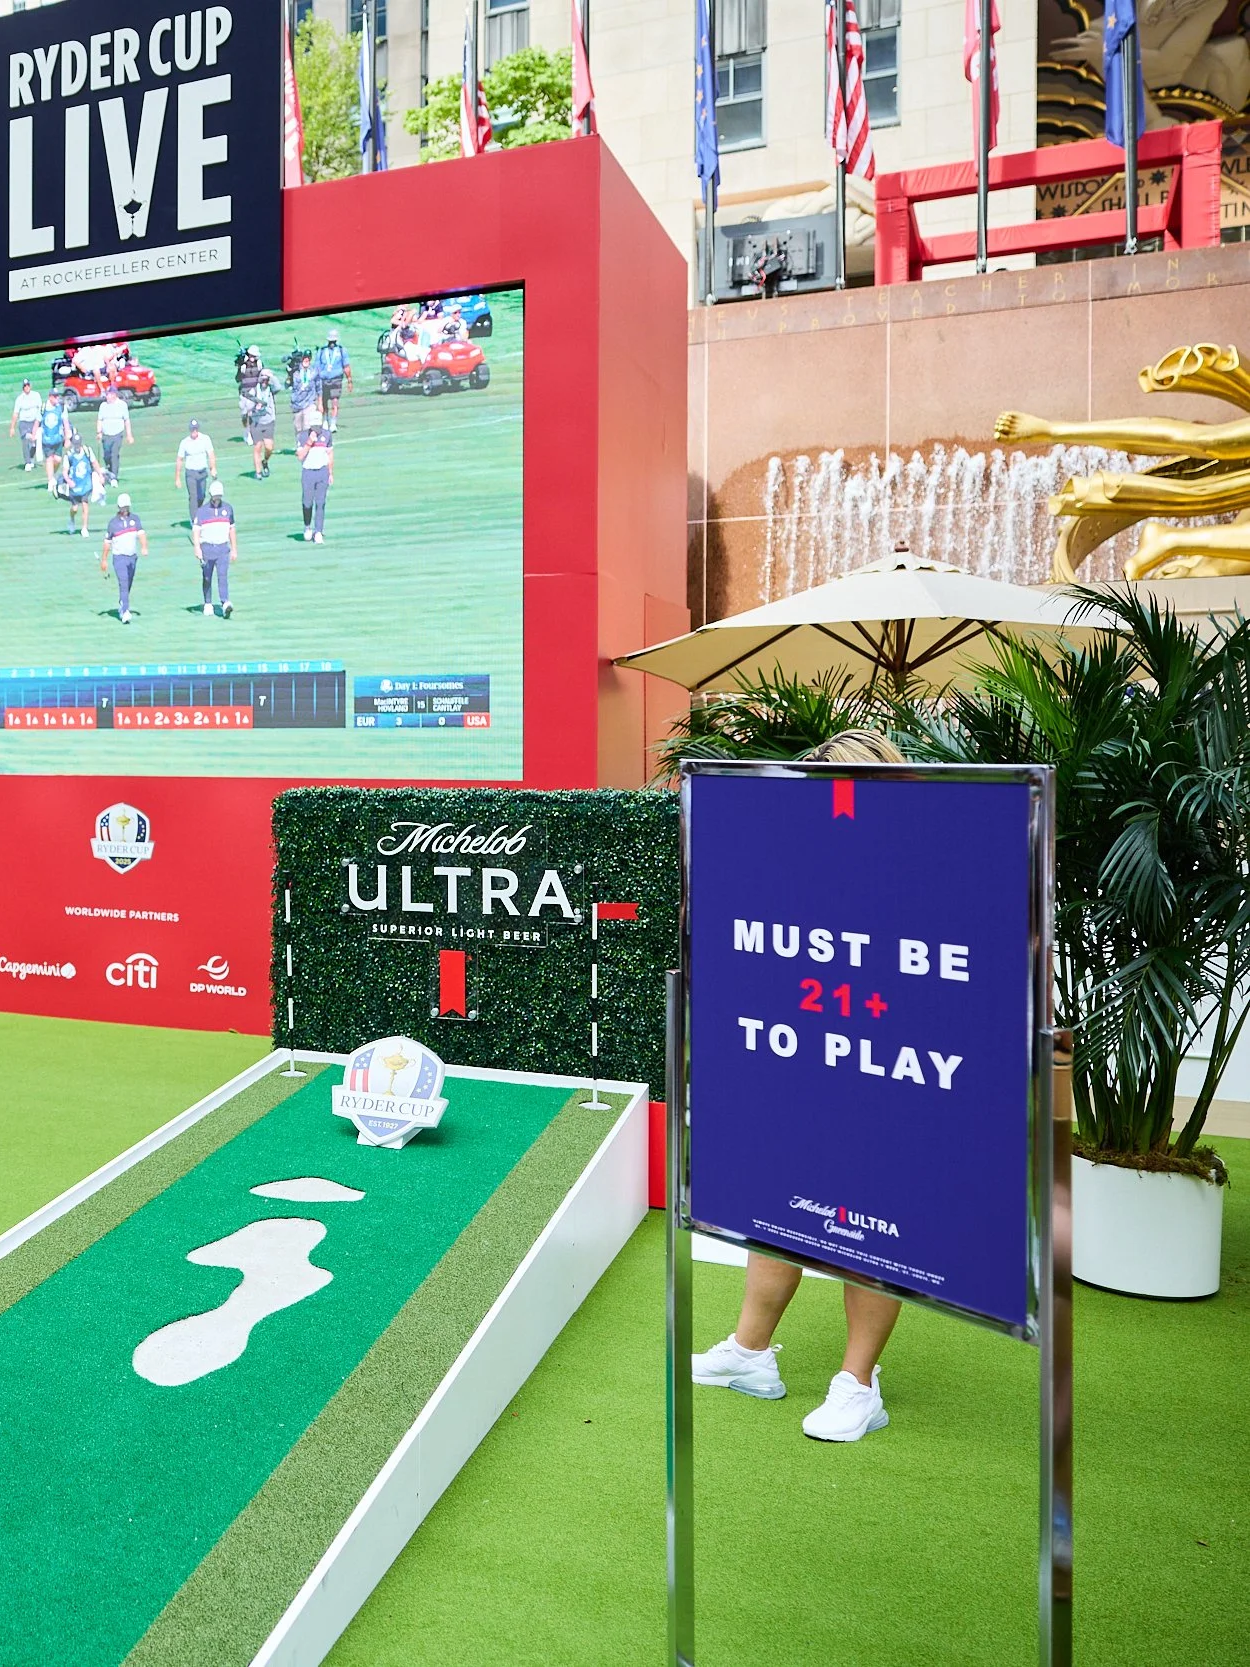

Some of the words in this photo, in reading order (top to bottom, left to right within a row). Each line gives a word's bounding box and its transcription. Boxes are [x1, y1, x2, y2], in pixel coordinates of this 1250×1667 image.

[9, 27, 140, 109] RYDER
[149, 6, 232, 76] CUP
[9, 74, 231, 258] LIVE
[19, 274, 38, 289] AT
[43, 260, 150, 287] ROCKEFELLER
[156, 249, 219, 268] CENTER
[395, 682, 411, 692] Day
[419, 682, 463, 690] Foursomes
[357, 717, 375, 726] EUR
[467, 717, 486, 725] USA
[97, 844, 129, 854] RYDER
[130, 845, 150, 855] CUP
[376, 822, 533, 856] Michelob
[347, 863, 576, 919] ULTRA
[65, 905, 126, 919] WORLDWIDE
[129, 910, 180, 922] PARTNERS
[372, 923, 444, 937] SUPERIOR
[451, 927, 495, 940] LIGHT
[503, 929, 542, 942] BEER
[733, 918, 871, 968] MUST
[898, 938, 971, 982] BE
[106, 953, 159, 989] citi
[190, 983, 205, 992] DP
[206, 984, 247, 997] WORLD
[799, 978, 889, 1018] 21+
[738, 1017, 799, 1058] TO
[824, 1033, 964, 1091] PLAY
[340, 1095, 395, 1113] RYDER
[399, 1102, 434, 1118] CUP
[789, 1195, 837, 1218] Michelob
[848, 1211, 900, 1238] ULTRA
